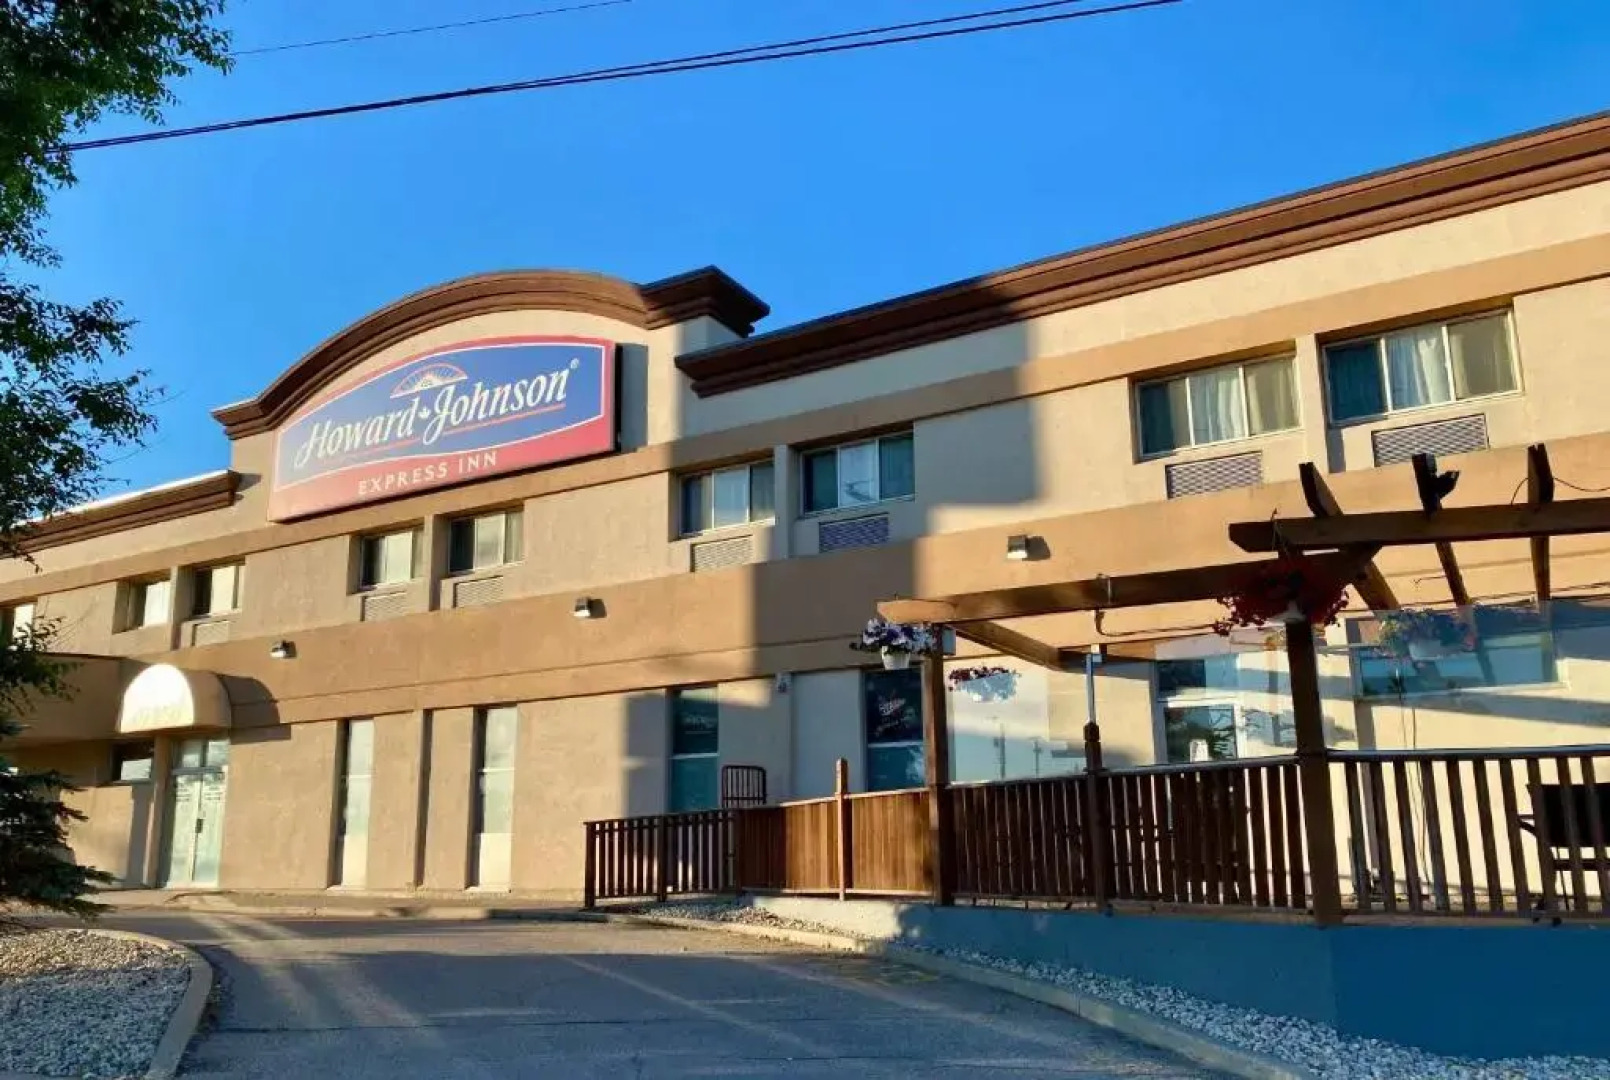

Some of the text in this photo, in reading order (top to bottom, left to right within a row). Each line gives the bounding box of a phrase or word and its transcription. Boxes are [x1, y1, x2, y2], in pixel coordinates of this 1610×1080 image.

[294, 368, 570, 469] Howard Johnson
[358, 450, 498, 495] EXPRESS INN
